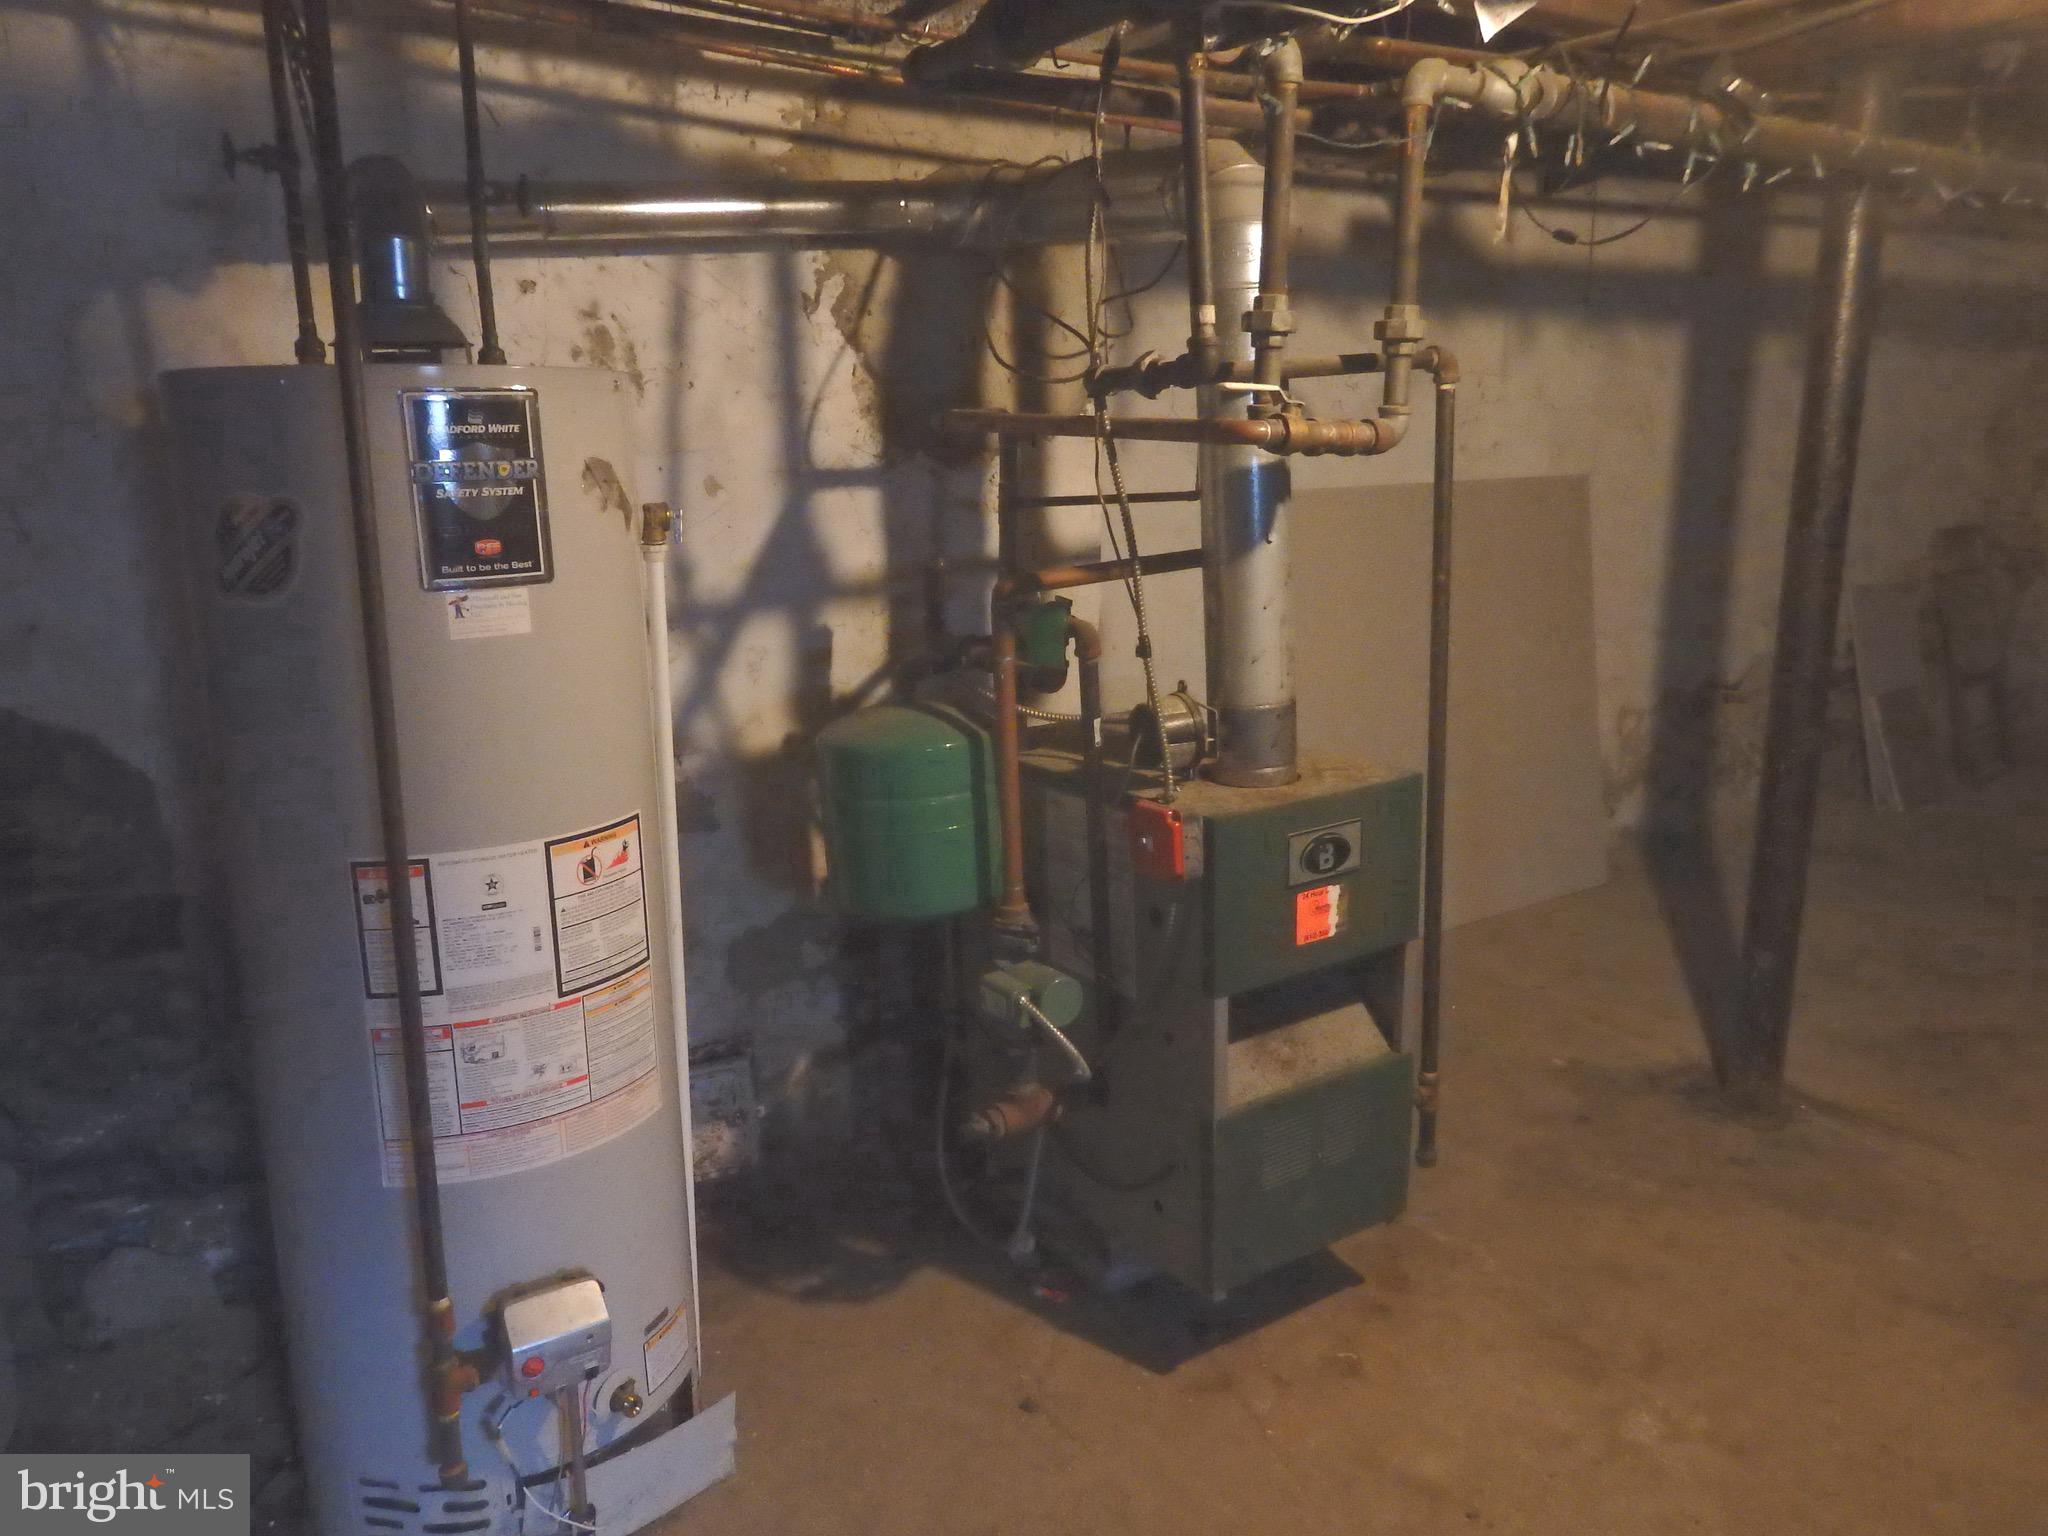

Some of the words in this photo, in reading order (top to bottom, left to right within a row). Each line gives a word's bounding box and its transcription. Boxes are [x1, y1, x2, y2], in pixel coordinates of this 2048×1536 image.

[488, 423, 521, 434] WHITE
[481, 486, 525, 497] SYSTEM
[441, 564, 464, 574] Built
[466, 564, 477, 573] to
[479, 563, 492, 572] be
[494, 561, 509, 570] the
[511, 560, 533, 569] Best
